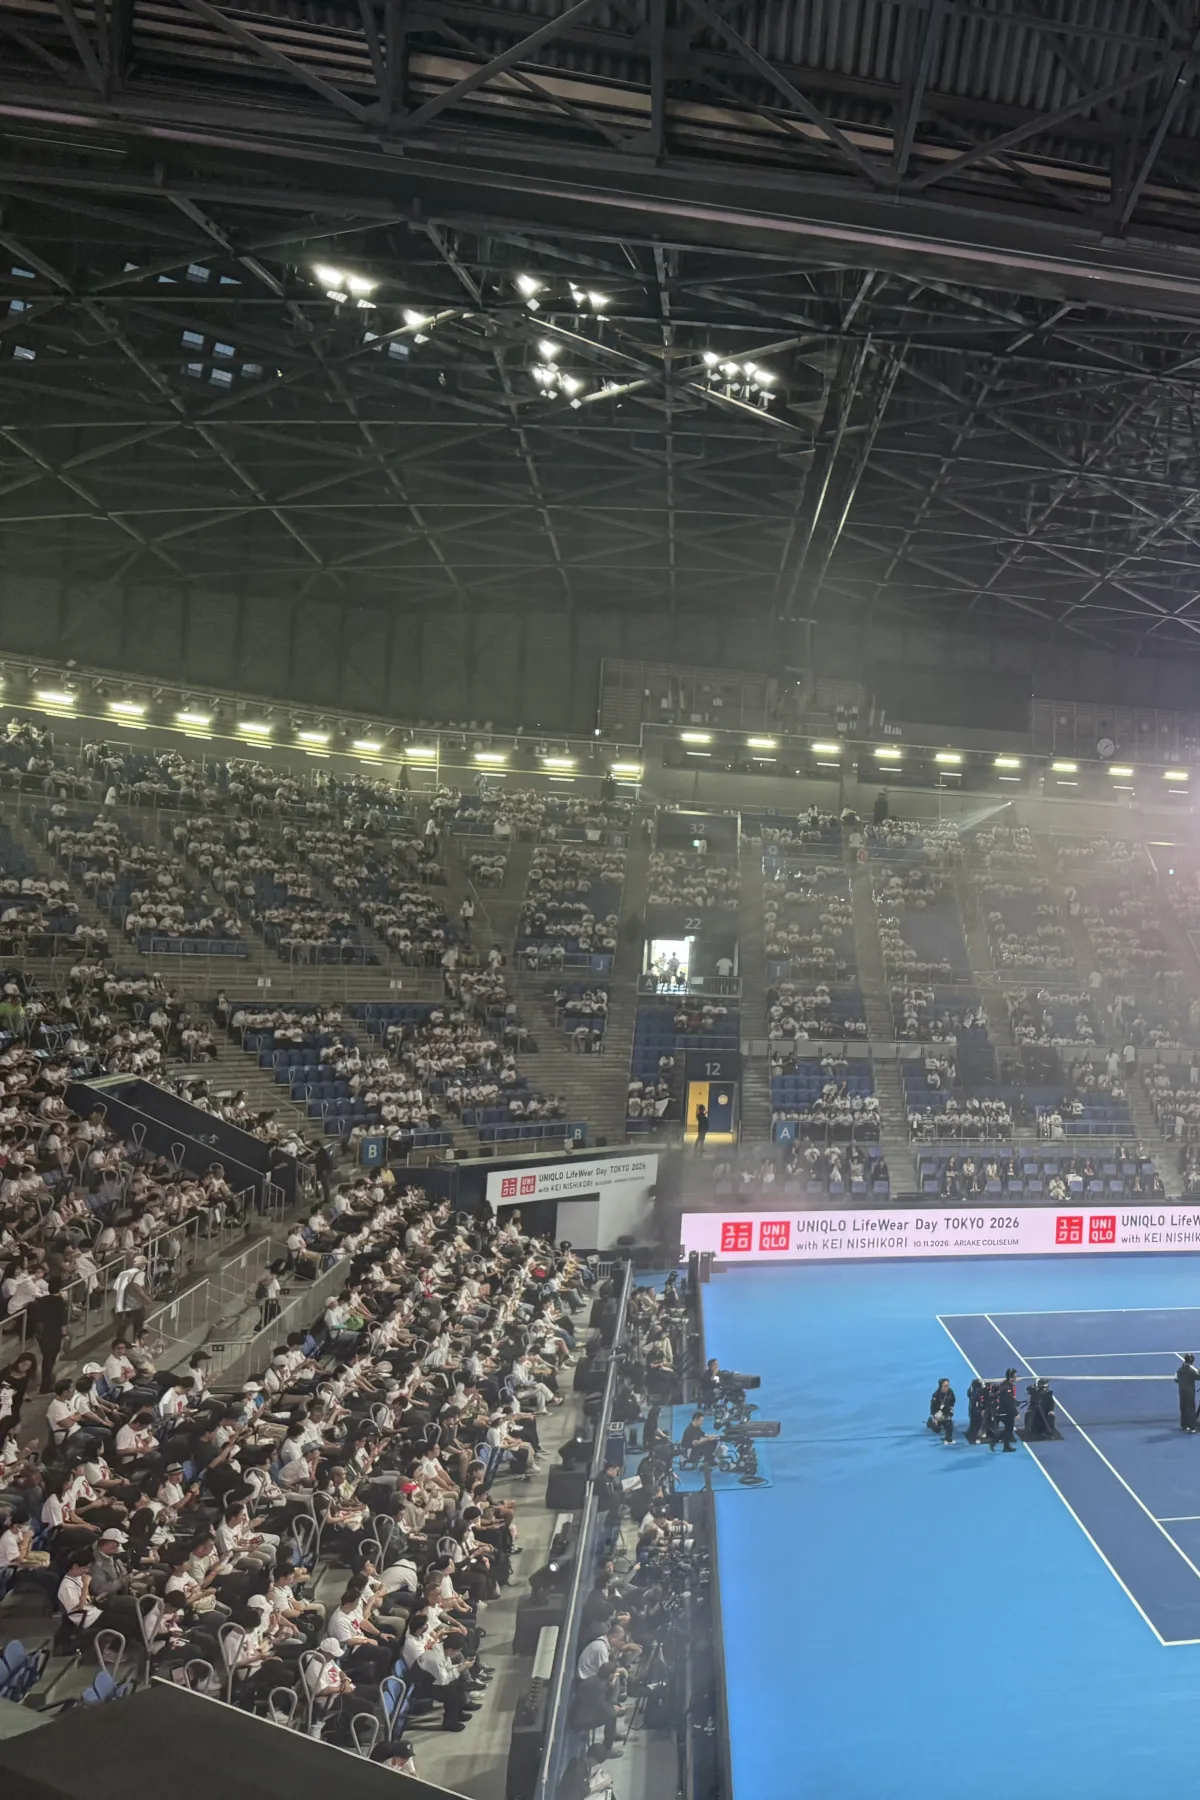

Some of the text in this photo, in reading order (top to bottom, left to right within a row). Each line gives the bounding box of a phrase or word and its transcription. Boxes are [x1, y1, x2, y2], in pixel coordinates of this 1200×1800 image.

[690, 823, 705, 834] 32
[684, 918, 702, 930] 22
[596, 960, 603, 970] J
[704, 1062, 721, 1076] 12
[574, 1129, 581, 1139] B
[780, 1128, 791, 1139] A
[368, 1144, 377, 1158] B
[539, 1172, 564, 1182] UNIQLO
[566, 1169, 593, 1179] LifeWear
[596, 1167, 607, 1176] Day
[610, 1164, 629, 1173] TOKYO
[797, 1216, 1020, 1233] UNIQLO LifeWear Day TOKYO 2026
[1060, 1218, 1080, 1230] ユニ
[1092, 1218, 1112, 1229] UNI
[1121, 1215, 1165, 1228] UNIQLO
[725, 1225, 749, 1236] ユニ
[762, 1224, 786, 1236] UNI
[1092, 1230, 1113, 1241] QLO
[1059, 1231, 1080, 1242] クロ
[1121, 1234, 1141, 1244] with
[1144, 1233, 1162, 1244] KEI
[724, 1239, 749, 1250] クロ
[762, 1237, 786, 1248] QLO
[796, 1237, 1019, 1250] with KEI NISHIKORI 10.11.2026 ARIAKE COLISEUM
